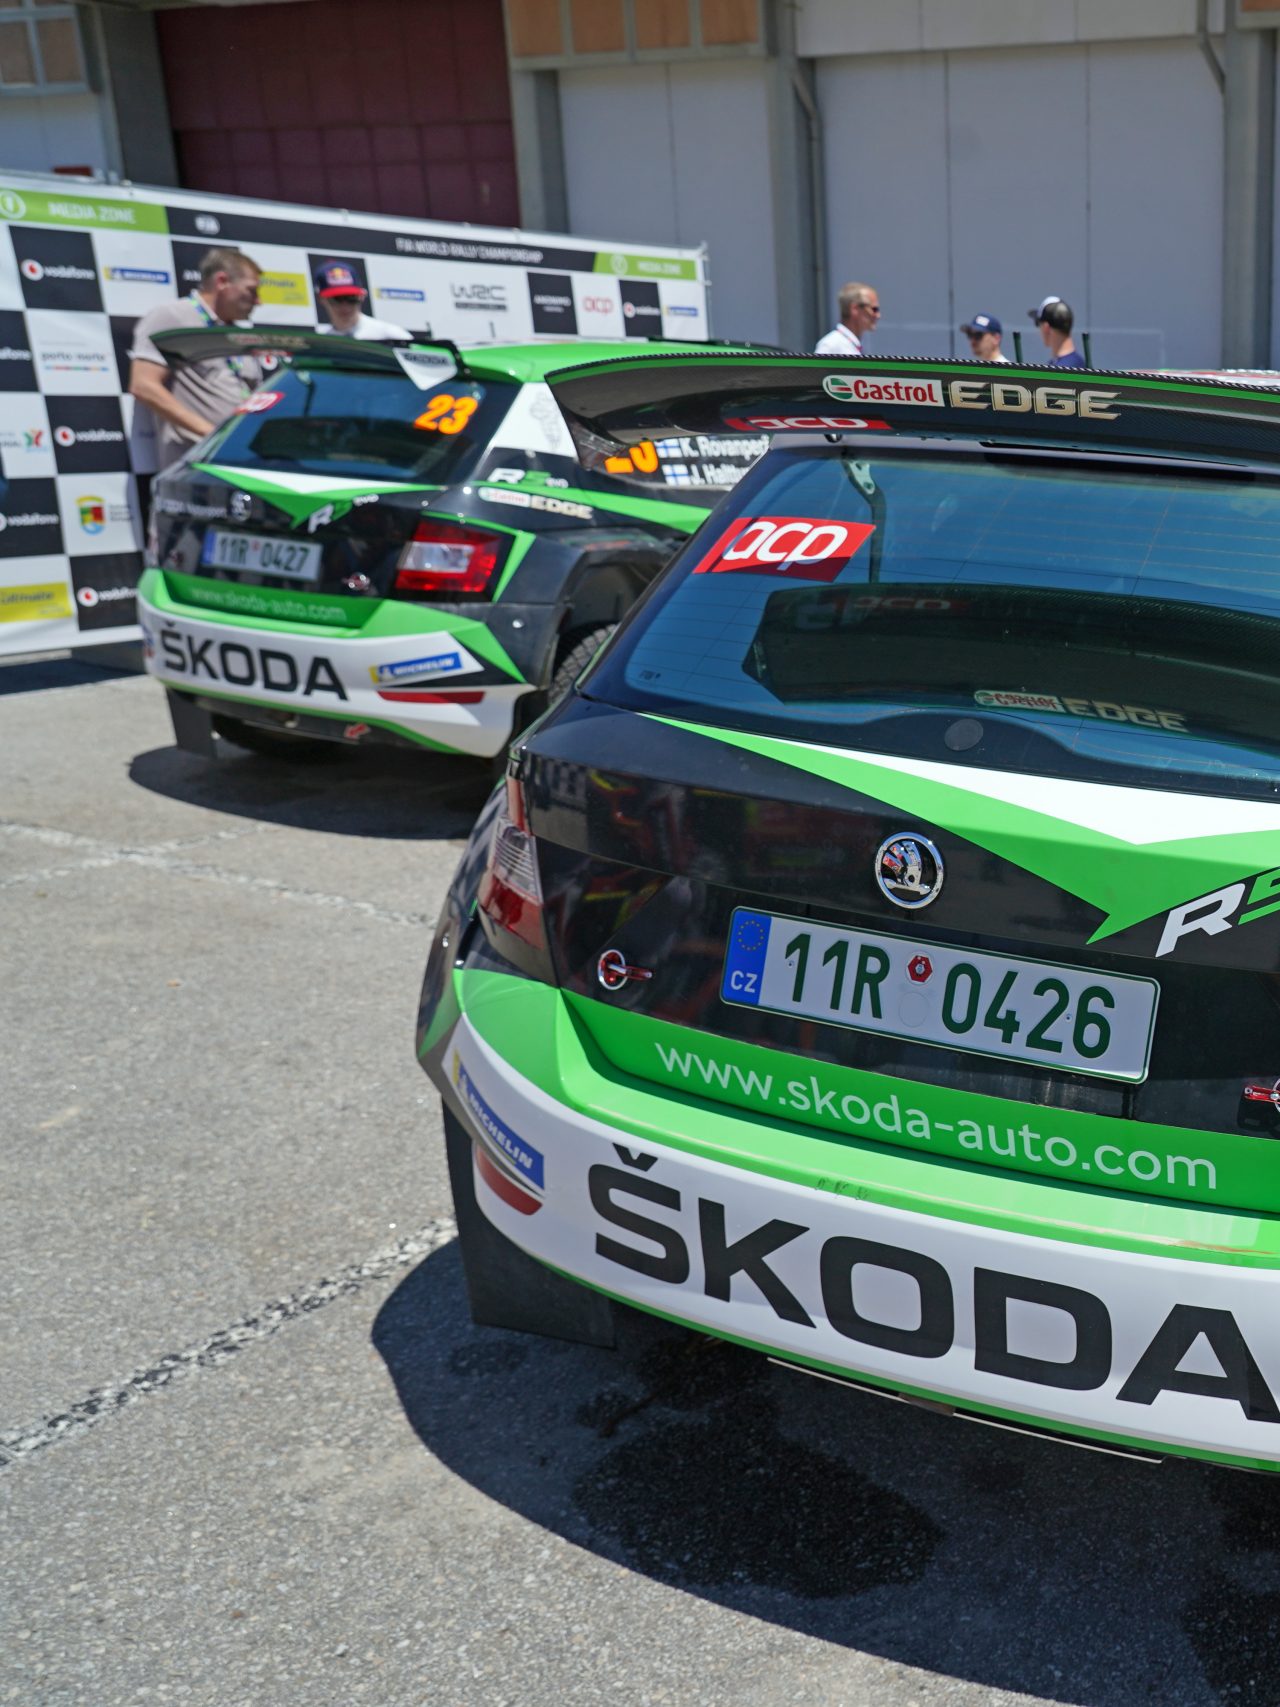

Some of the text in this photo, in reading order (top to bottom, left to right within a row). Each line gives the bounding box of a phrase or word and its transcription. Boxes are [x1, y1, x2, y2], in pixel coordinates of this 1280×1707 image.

[47, 201, 137, 224] MEDIA ZONE
[451, 283, 505, 302] WRC
[413, 394, 479, 435] 23
[853, 379, 1122, 420] Castrol EDGE
[678, 437, 699, 458] K.
[220, 535, 311, 573] 11R 0427
[721, 520, 849, 572] acp
[159, 620, 350, 701] ŠKODA
[730, 967, 758, 996] CZ
[785, 932, 1116, 1060] 11R 0426
[469, 1096, 535, 1170] MICHELIN
[654, 1041, 1218, 1190] www.skoda-auto.com
